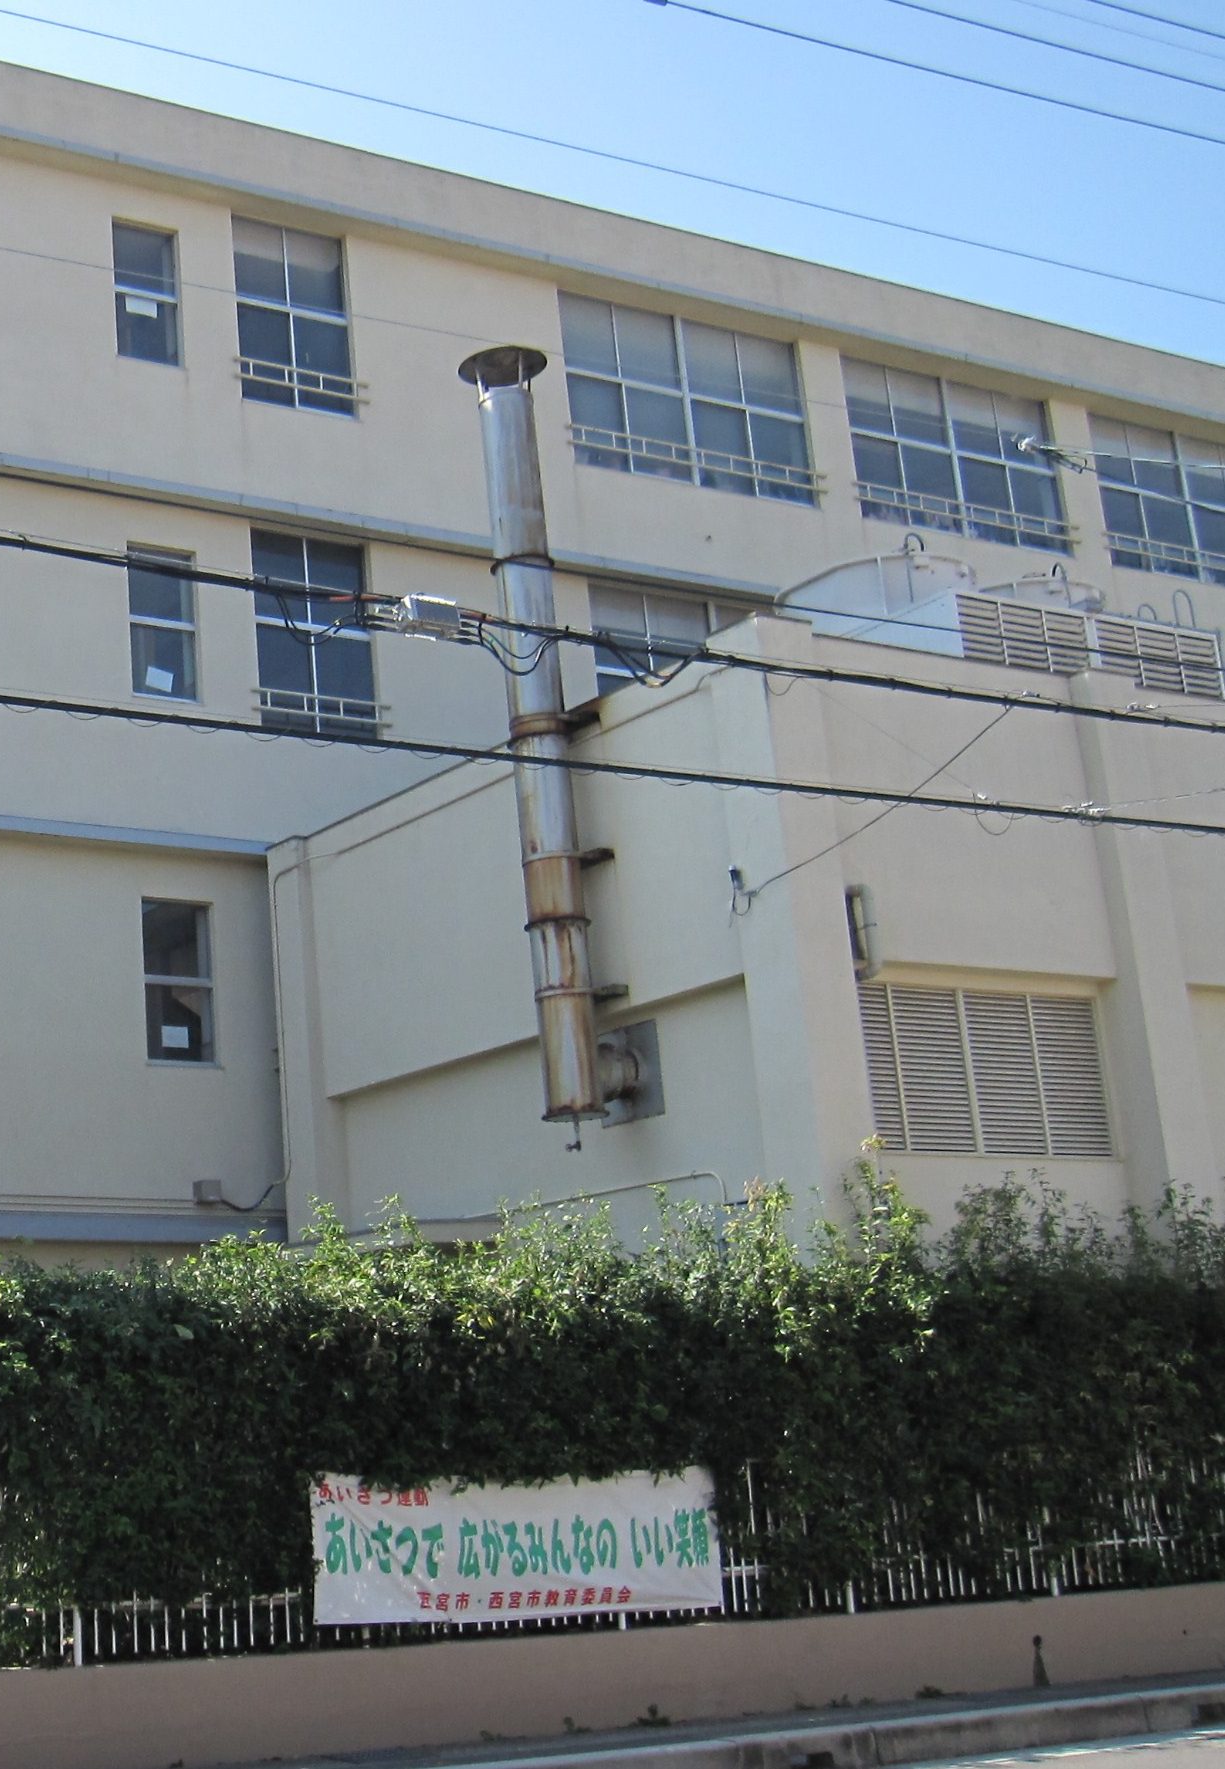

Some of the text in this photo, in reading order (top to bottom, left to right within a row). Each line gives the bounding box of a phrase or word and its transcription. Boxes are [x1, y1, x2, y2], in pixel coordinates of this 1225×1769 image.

[325, 1507, 710, 1579] あいさつで 広がるみんなの いい笑顔
